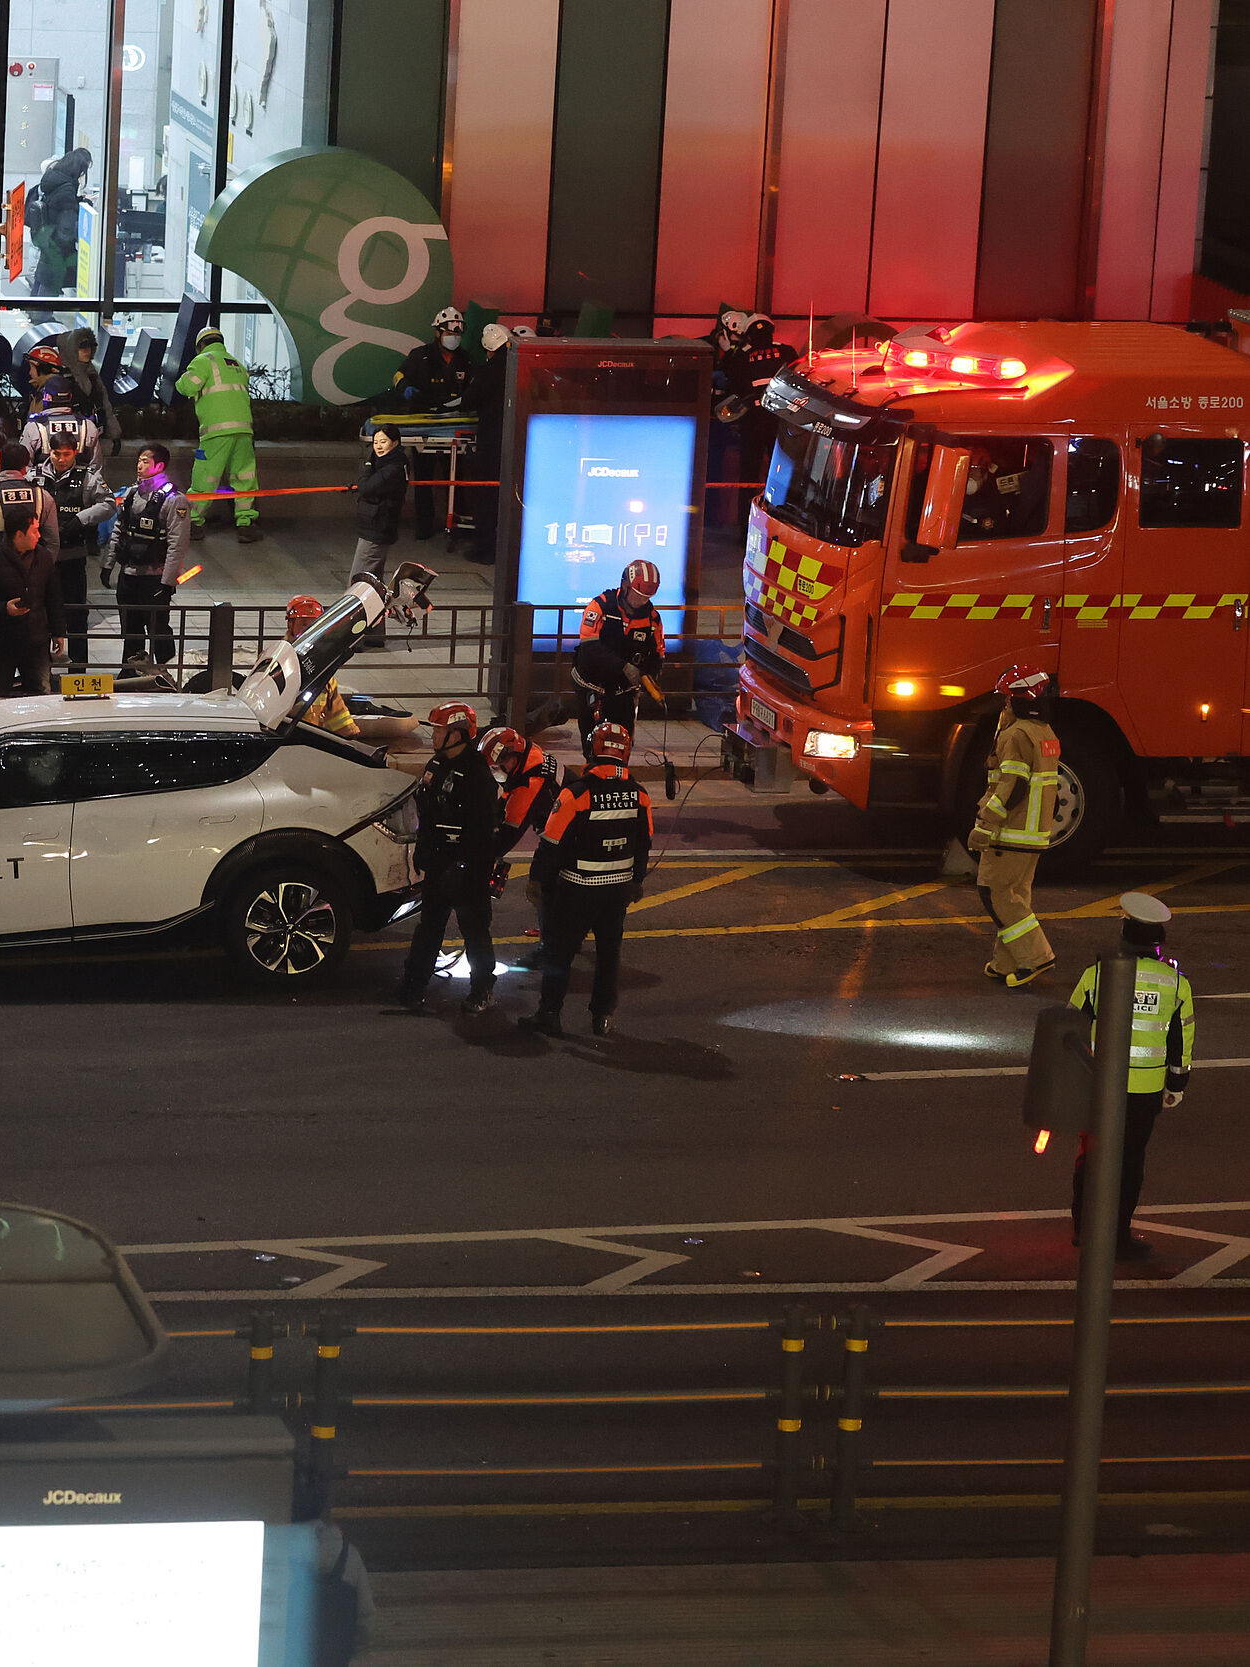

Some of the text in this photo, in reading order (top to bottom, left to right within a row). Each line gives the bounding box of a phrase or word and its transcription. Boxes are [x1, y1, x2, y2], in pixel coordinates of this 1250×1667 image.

[598, 360, 635, 368] JCDecaux
[1145, 395, 1244, 410] 서울소방 종로200
[587, 466, 639, 478] JCDecaux
[73, 678, 102, 692] 인천
[593, 791, 638, 803] 119구조대
[600, 801, 634, 810] RESCUE
[6, 857, 25, 879] T
[42, 1489, 122, 1506] JCDecaux
